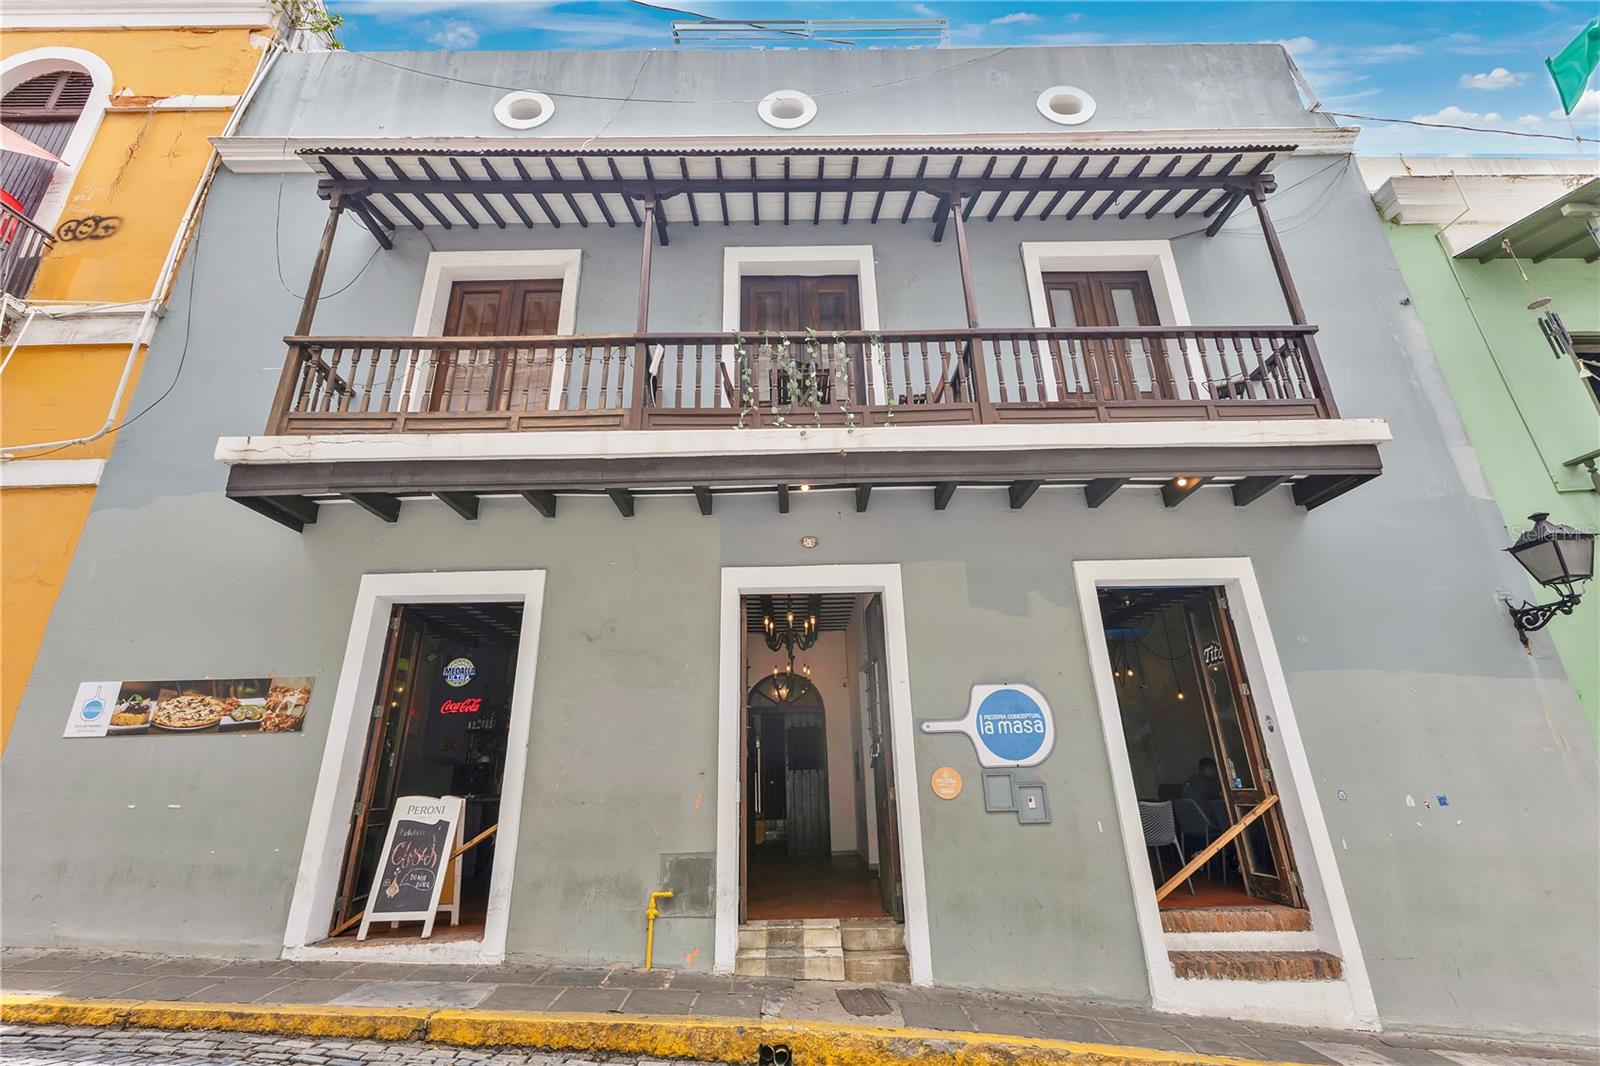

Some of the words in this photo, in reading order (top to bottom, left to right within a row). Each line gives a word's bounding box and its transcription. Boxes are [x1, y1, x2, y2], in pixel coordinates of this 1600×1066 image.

[979, 715, 994, 735] la
[998, 719, 1044, 734] masa
[407, 805, 446, 815] PERONI
